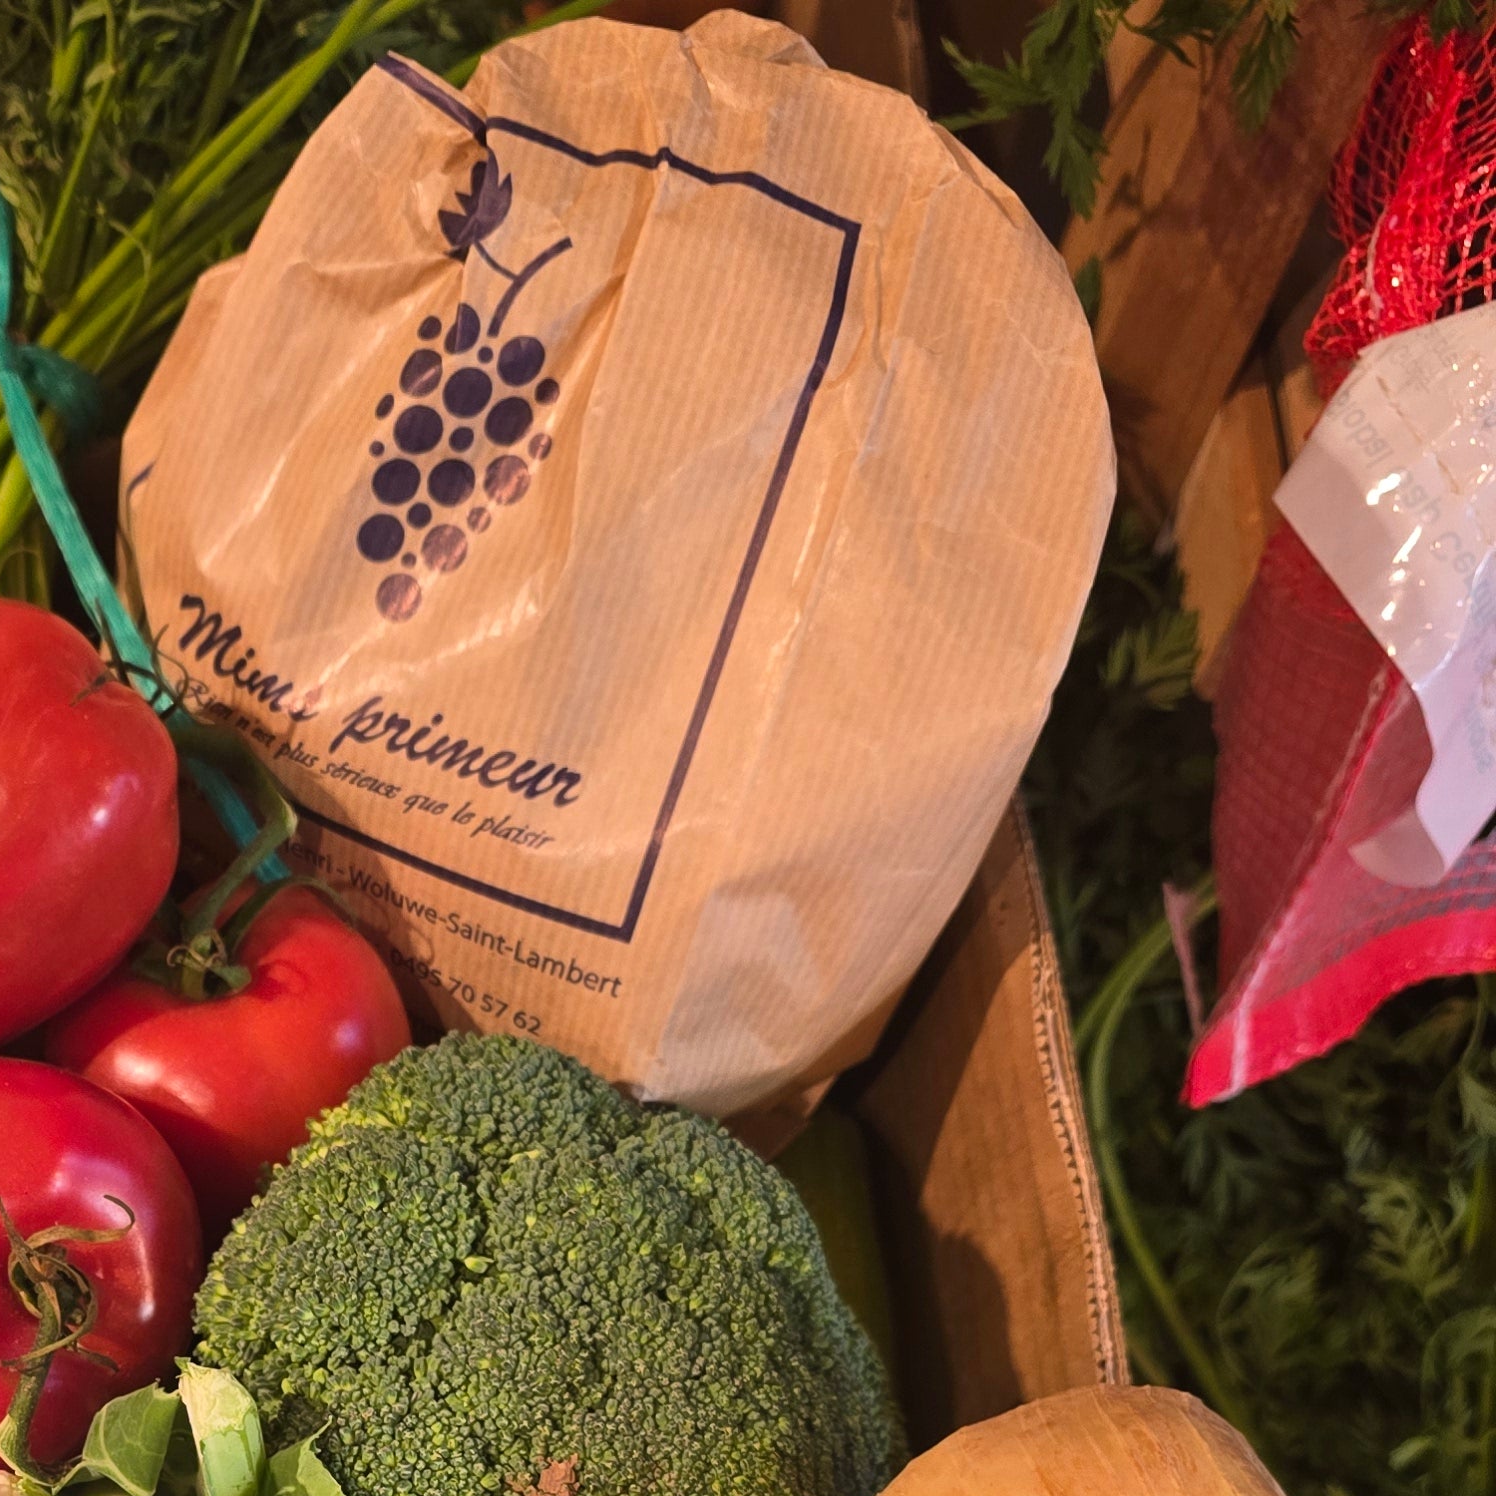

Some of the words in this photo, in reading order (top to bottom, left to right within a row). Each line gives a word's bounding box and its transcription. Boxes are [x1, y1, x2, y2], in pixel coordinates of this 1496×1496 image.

[176, 677, 234, 720] Rien
[235, 716, 277, 748] n'est
[273, 741, 320, 769] plus
[319, 761, 402, 800] sérieux
[402, 793, 450, 817] que
[451, 801, 477, 826] le
[470, 815, 556, 850] plaisir
[329, 696, 583, 808] primeur
[349, 865, 623, 999] Woluwe-Saint-Lambert
[390, 946, 443, 987] 0495
[448, 976, 476, 1005] 70
[480, 993, 509, 1019] 57
[513, 1011, 543, 1037] 62
